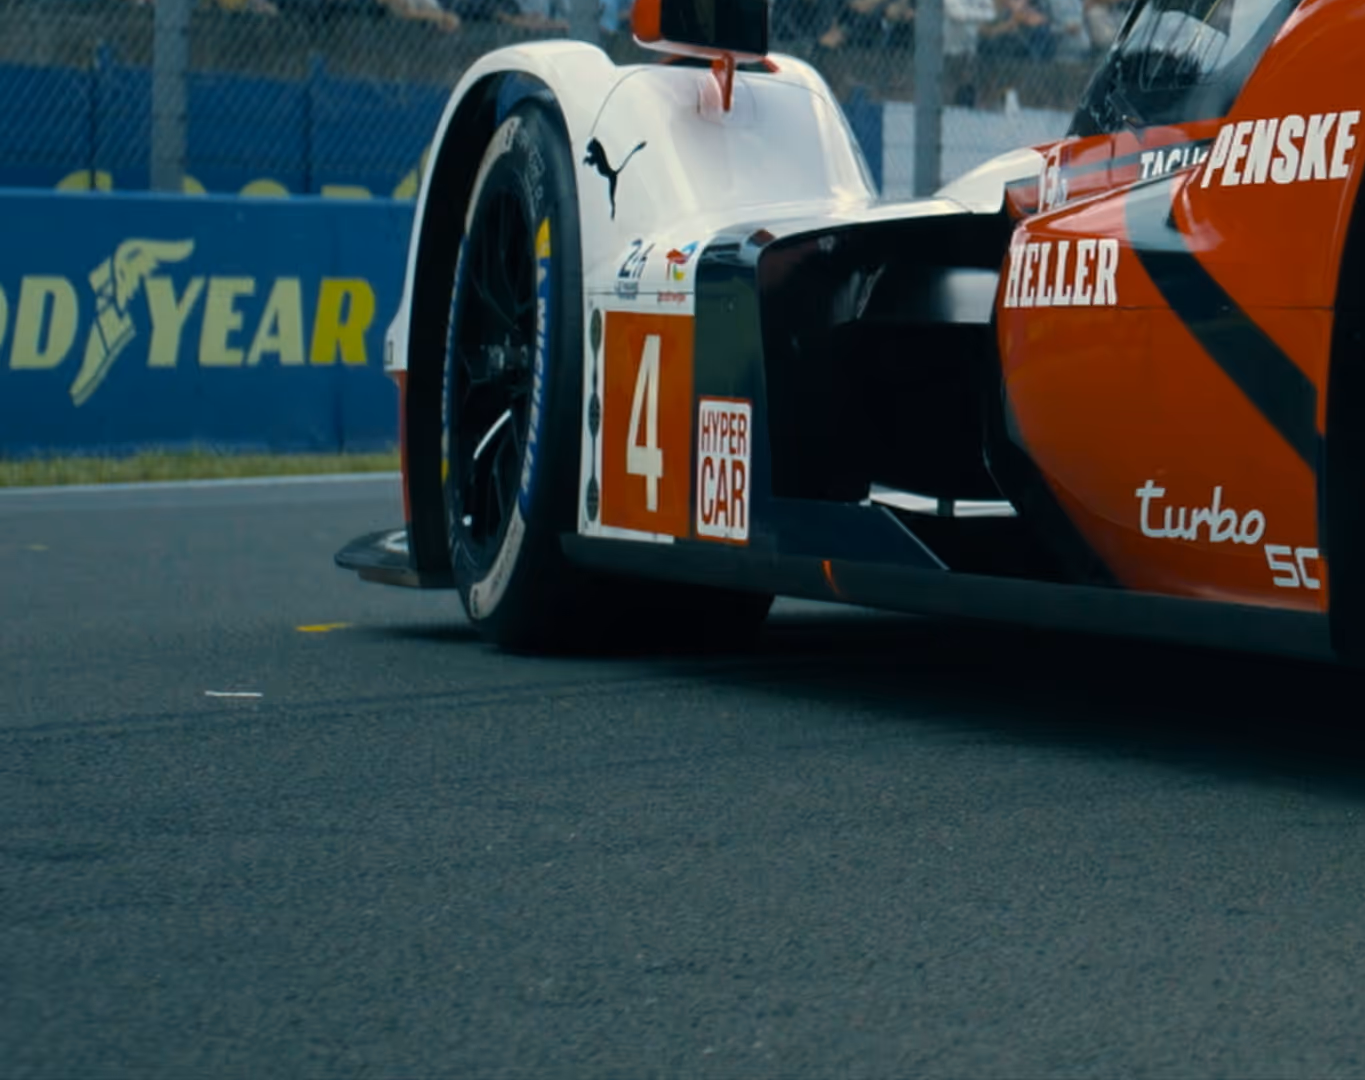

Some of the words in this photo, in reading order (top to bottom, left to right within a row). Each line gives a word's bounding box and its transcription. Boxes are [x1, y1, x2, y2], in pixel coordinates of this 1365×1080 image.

[1201, 110, 1361, 189] PENSKE
[1004, 239, 1118, 308] HELLER
[627, 334, 664, 513] 4
[701, 410, 747, 455] HYPER
[700, 456, 746, 529] CAR
[1135, 480, 1266, 545] turbo
